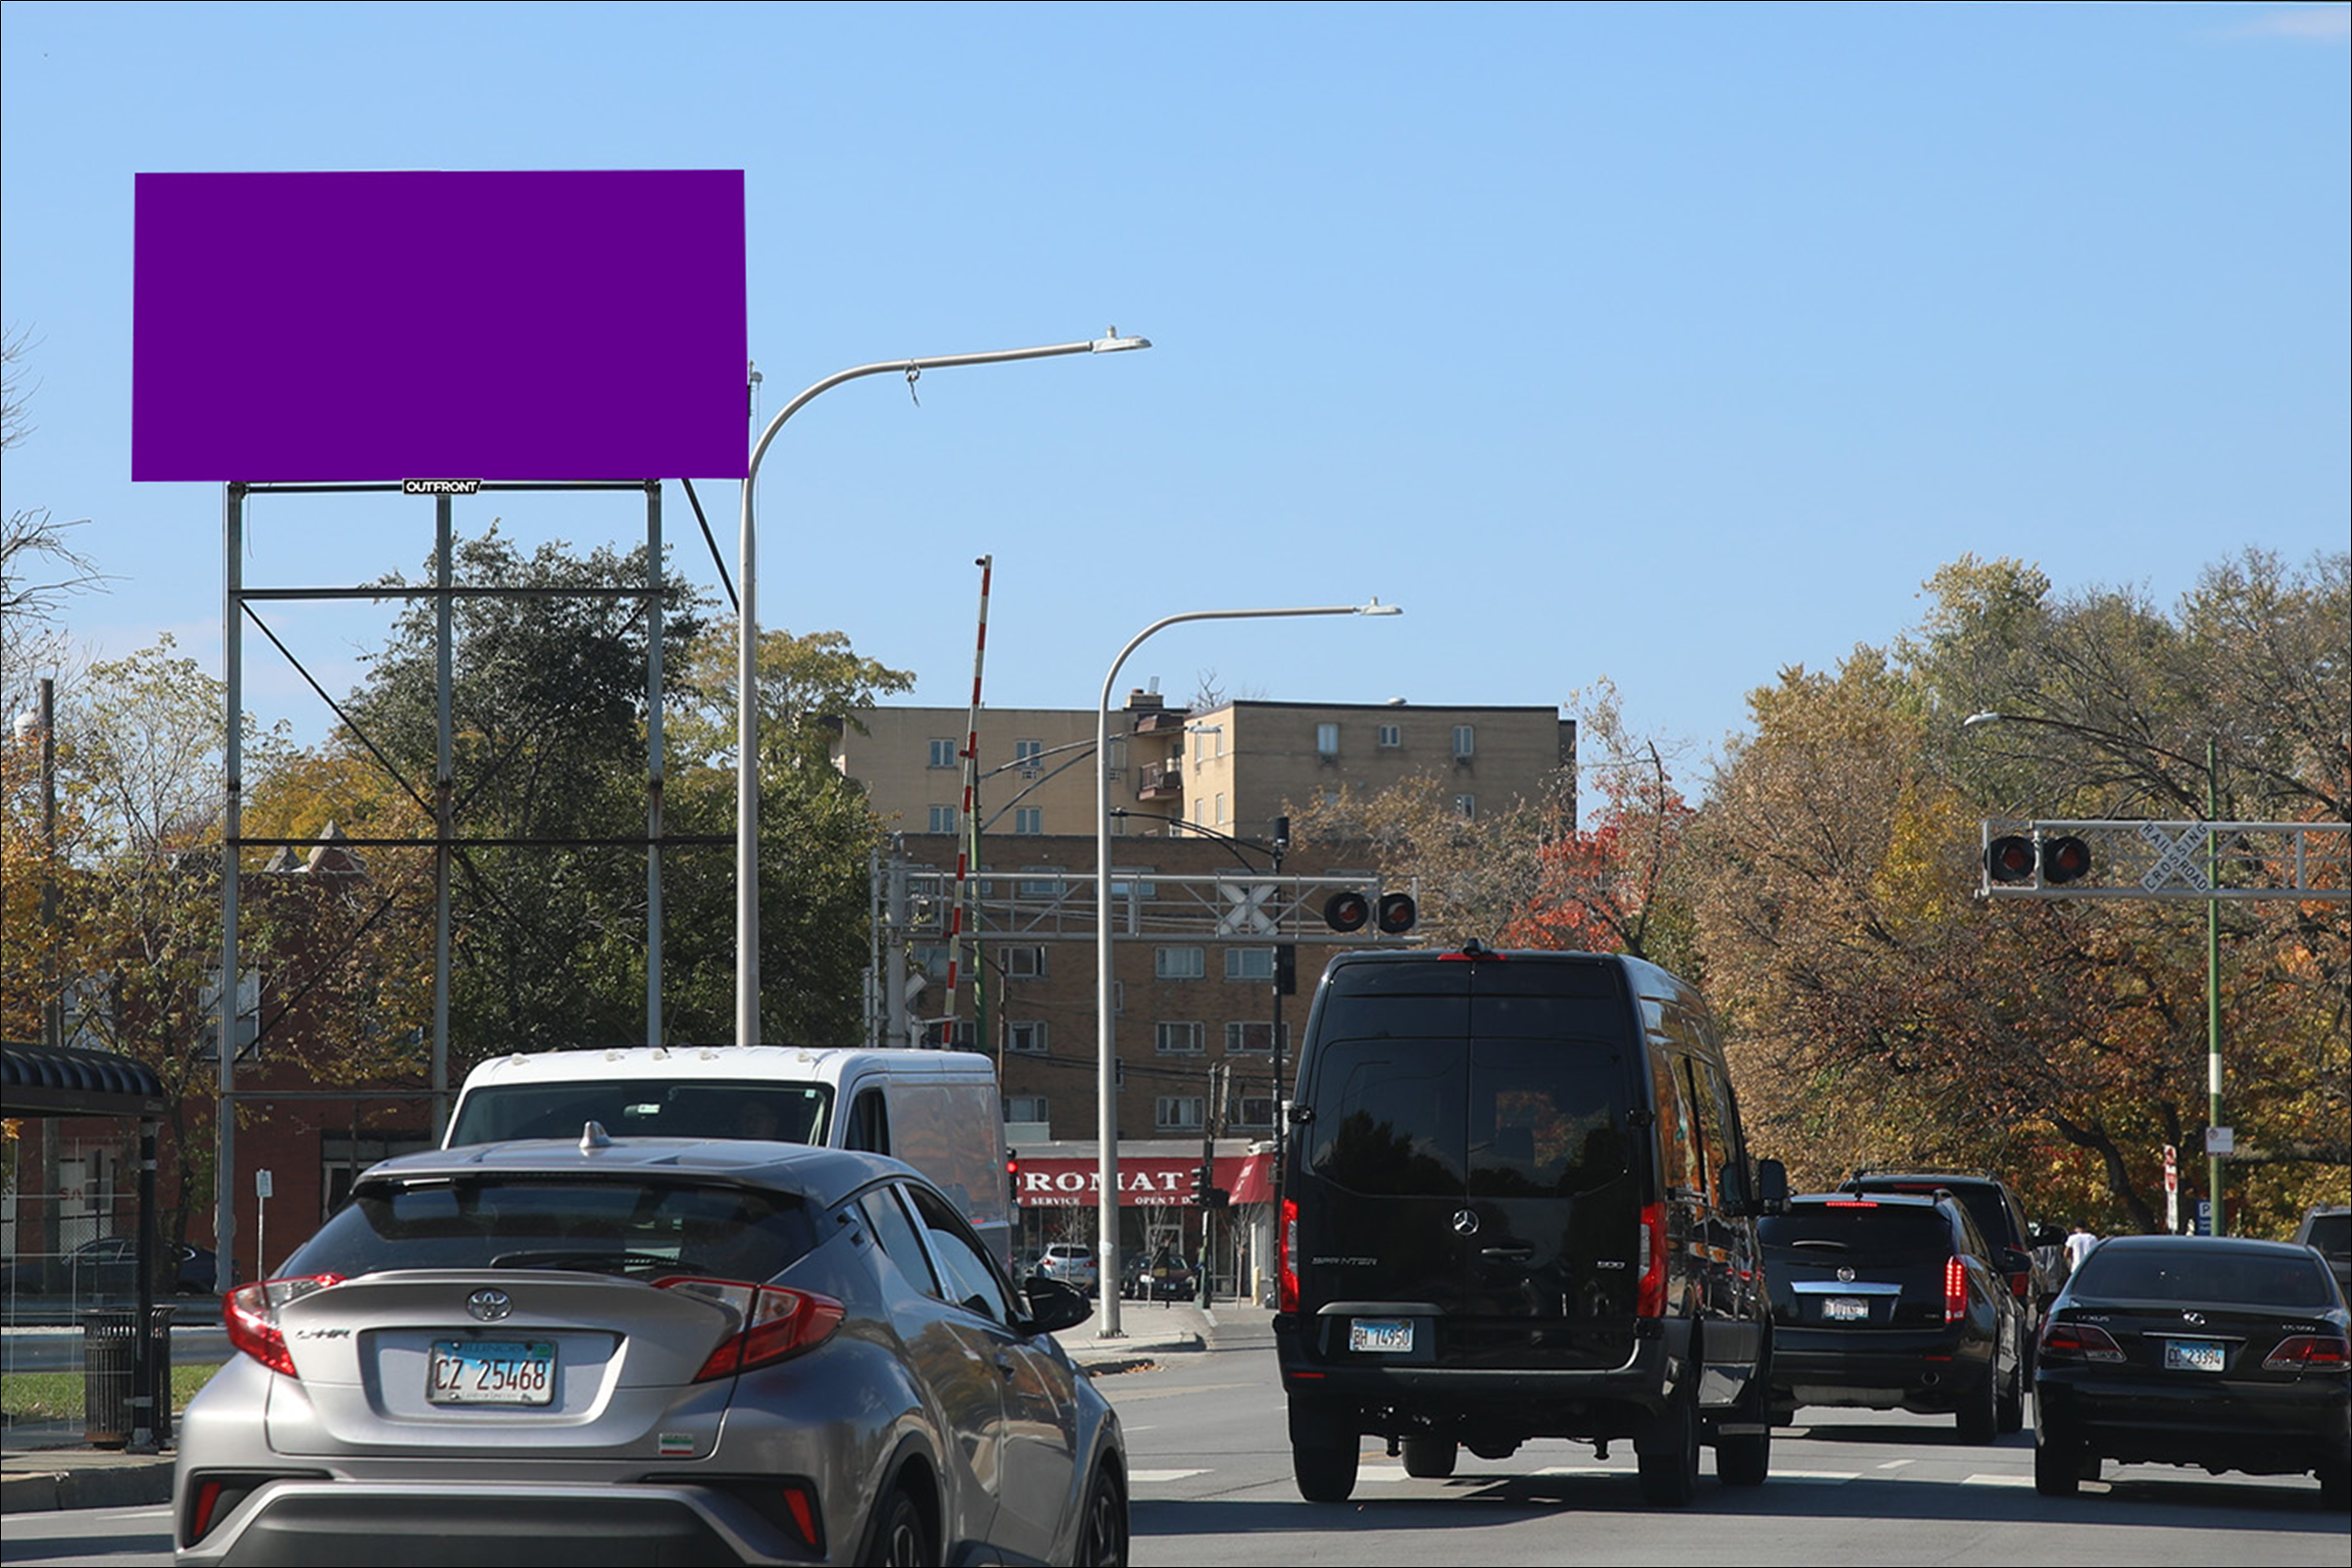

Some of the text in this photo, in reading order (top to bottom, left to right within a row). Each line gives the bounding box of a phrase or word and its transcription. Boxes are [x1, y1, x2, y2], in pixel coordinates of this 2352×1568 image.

[406, 481, 477, 492] OUTFRONT
[2144, 823, 2208, 890] CROSSING
[1016, 1172, 1184, 1192] ROMAT
[1031, 1197, 1080, 1205] SERVICE
[1135, 1197, 1166, 1205] OPEN
[1169, 1197, 1175, 1205] 7
[435, 1358, 546, 1391] CZ 25468
